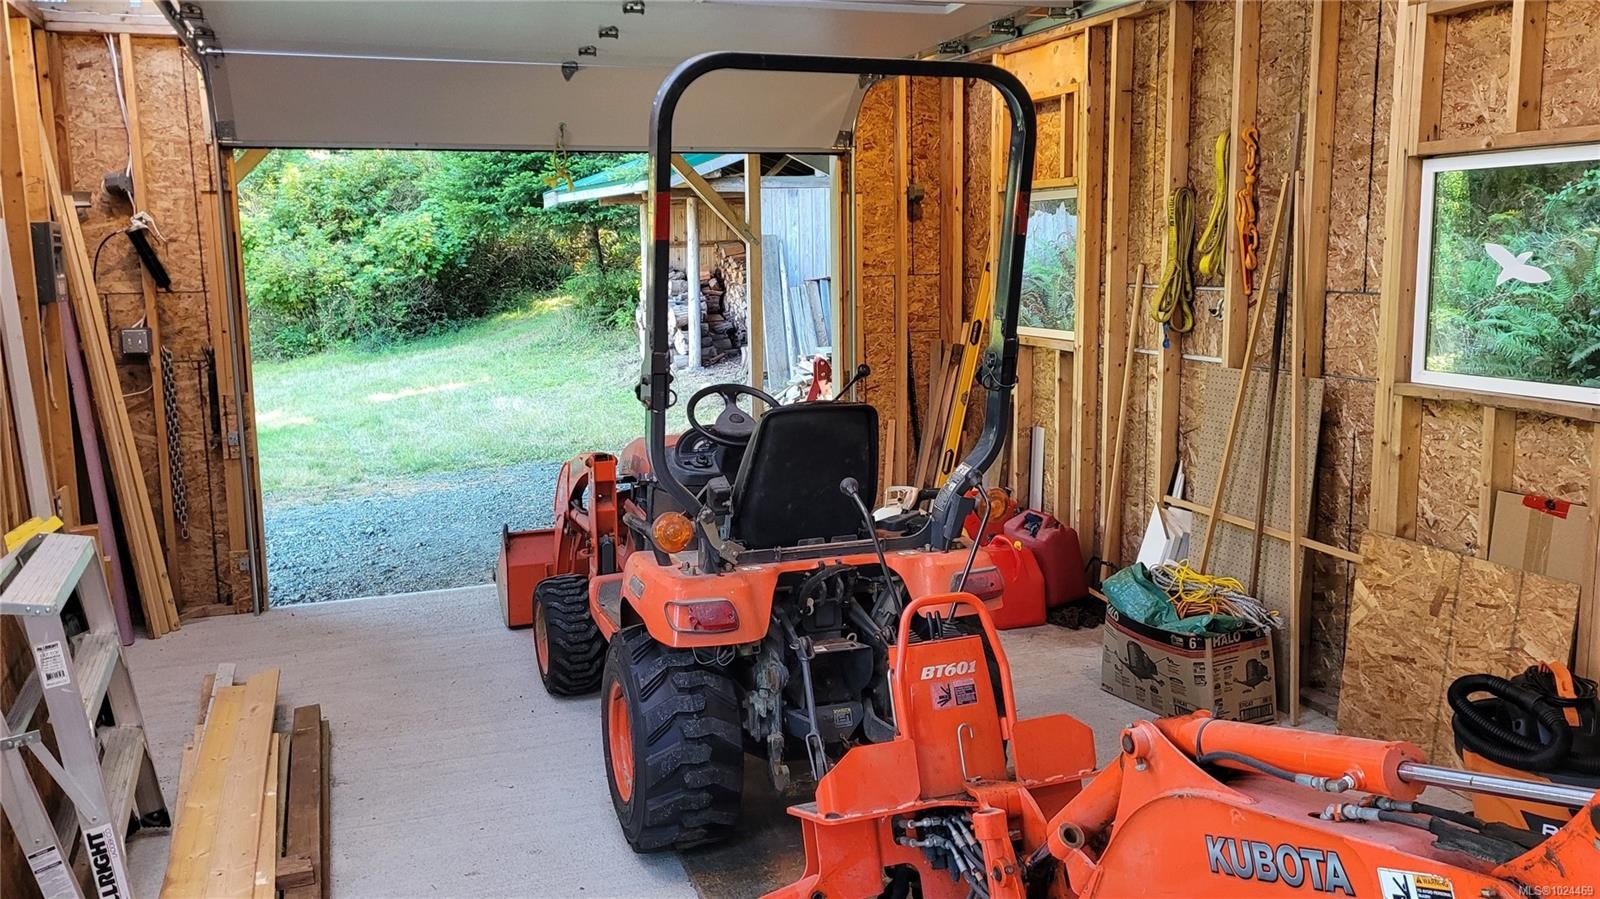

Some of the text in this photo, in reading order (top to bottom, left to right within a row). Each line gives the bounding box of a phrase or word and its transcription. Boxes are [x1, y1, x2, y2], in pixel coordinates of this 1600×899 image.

[1212, 630, 1242, 648] HALO
[920, 660, 977, 681] BT601
[1205, 834, 1357, 898] KUBOTA
